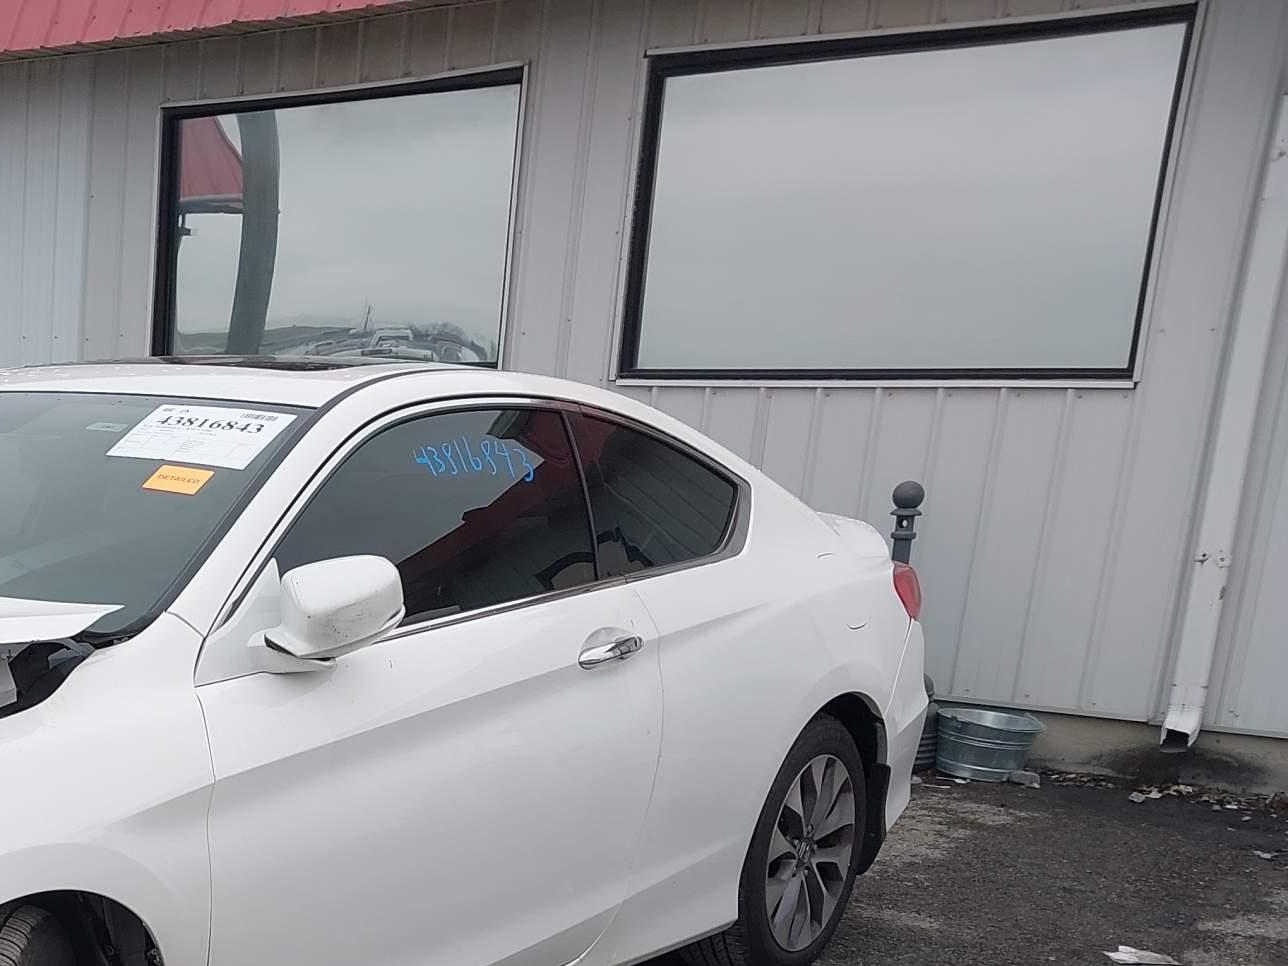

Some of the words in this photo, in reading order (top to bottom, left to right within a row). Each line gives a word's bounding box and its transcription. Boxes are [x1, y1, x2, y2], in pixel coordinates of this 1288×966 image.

[156, 415, 265, 434] 43816843
[413, 436, 533, 482] 43816843
[157, 474, 201, 484] DETAILED
